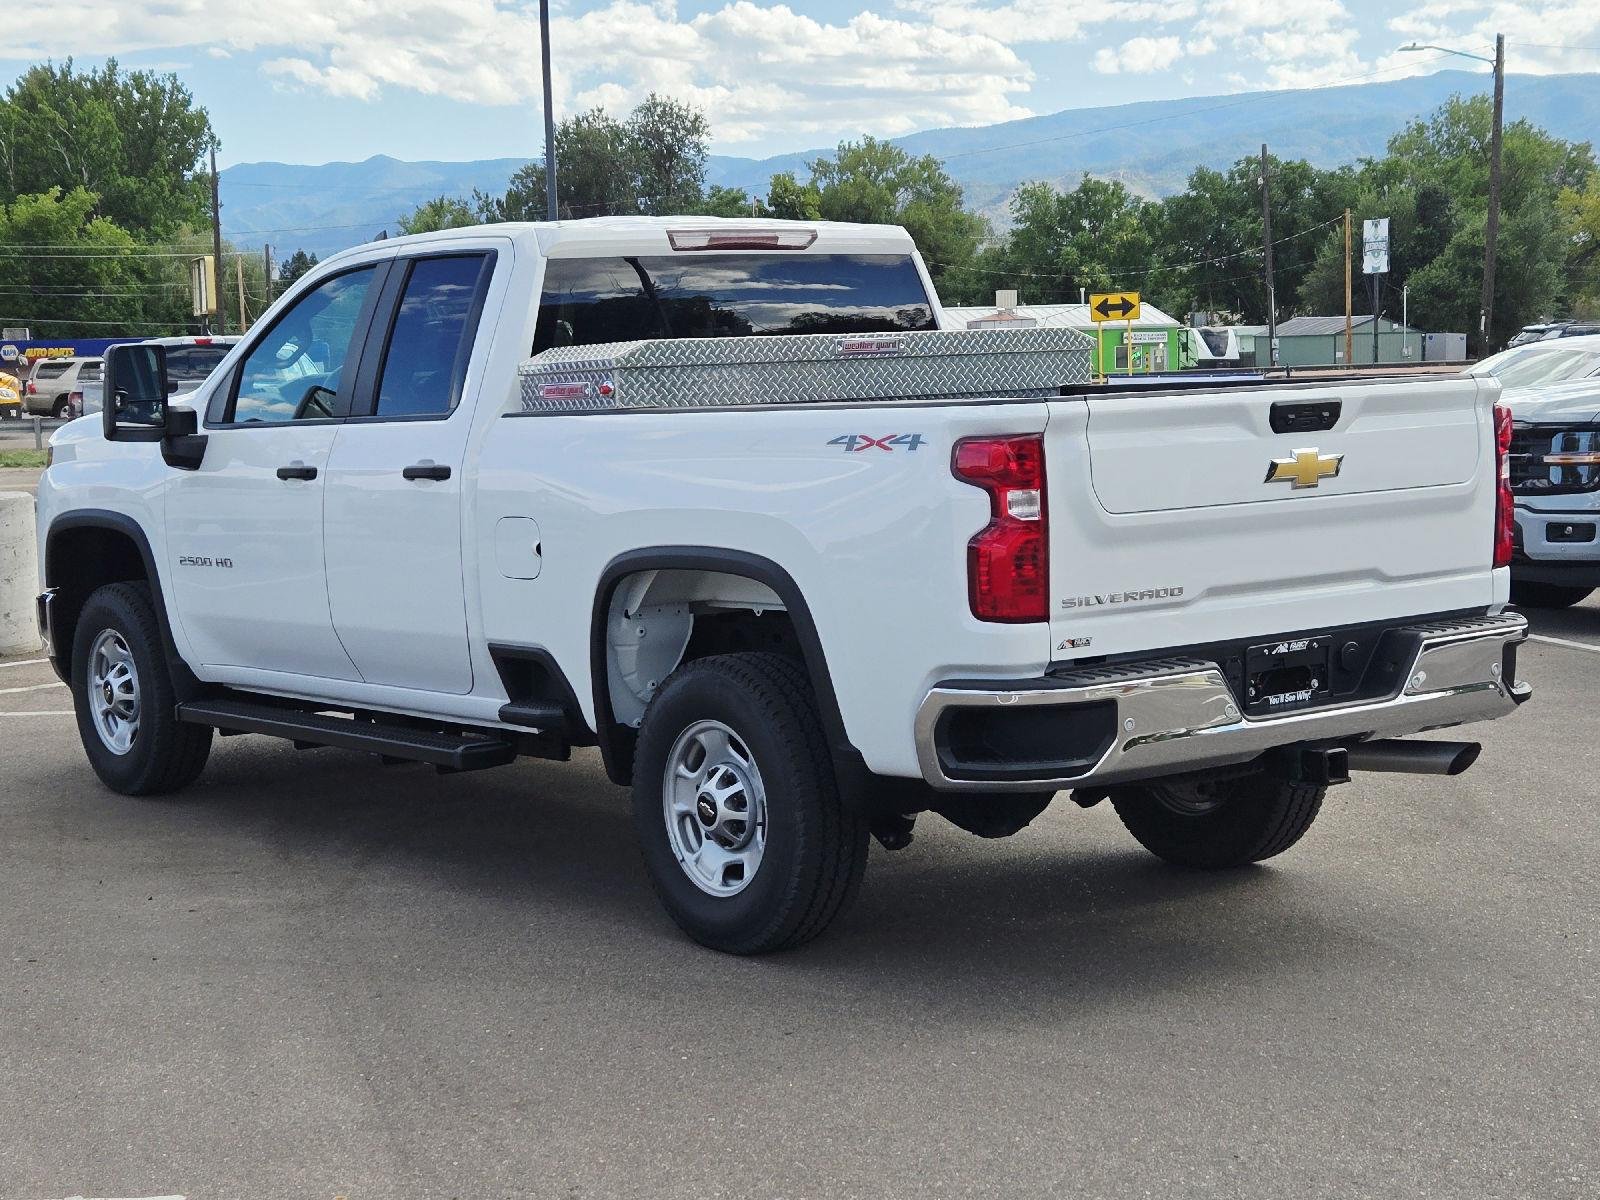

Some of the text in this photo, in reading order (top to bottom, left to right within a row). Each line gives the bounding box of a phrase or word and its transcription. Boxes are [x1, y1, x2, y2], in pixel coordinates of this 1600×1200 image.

[844, 340, 898, 350] weather guard
[25, 347, 75, 357] AUTO PARTS
[179, 556, 233, 568] 2500 HD
[1061, 586, 1184, 609] SILVERADO
[1285, 692, 1296, 702] See
